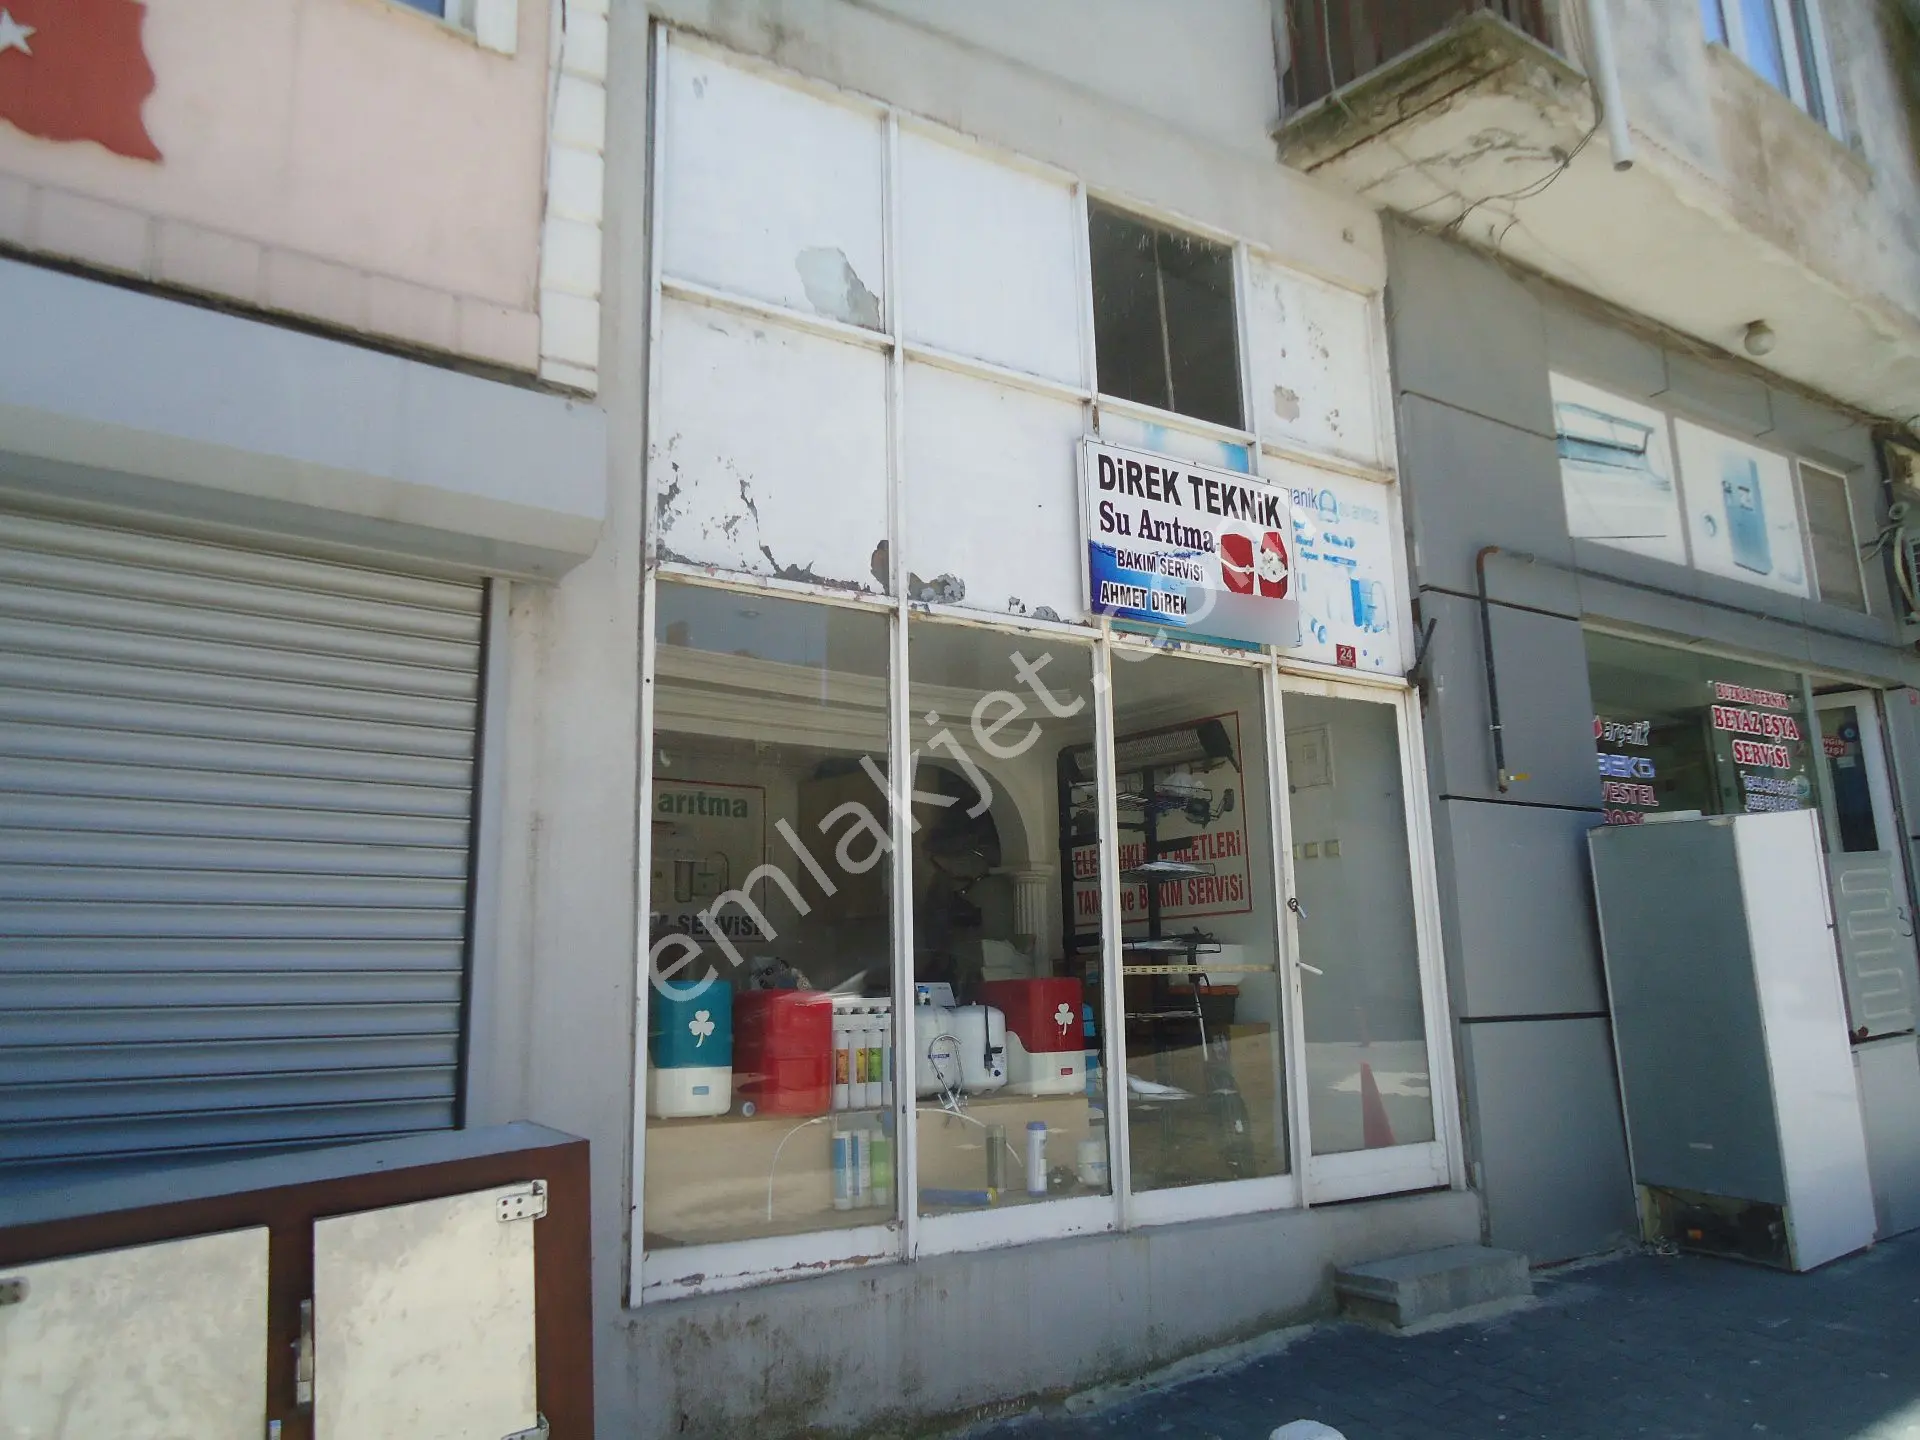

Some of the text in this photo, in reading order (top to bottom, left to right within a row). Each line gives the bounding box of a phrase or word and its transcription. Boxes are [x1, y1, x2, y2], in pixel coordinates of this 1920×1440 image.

[1290, 487, 1318, 510] anik
[1099, 500, 1132, 537] Su
[1116, 549, 1157, 574] BAKIM
[1100, 582, 1148, 610] AHMET
[1340, 648, 1354, 661] 24
[1711, 705, 1800, 743] BEYAZ EŞYA
[1138, 880, 1183, 911] BKIM
